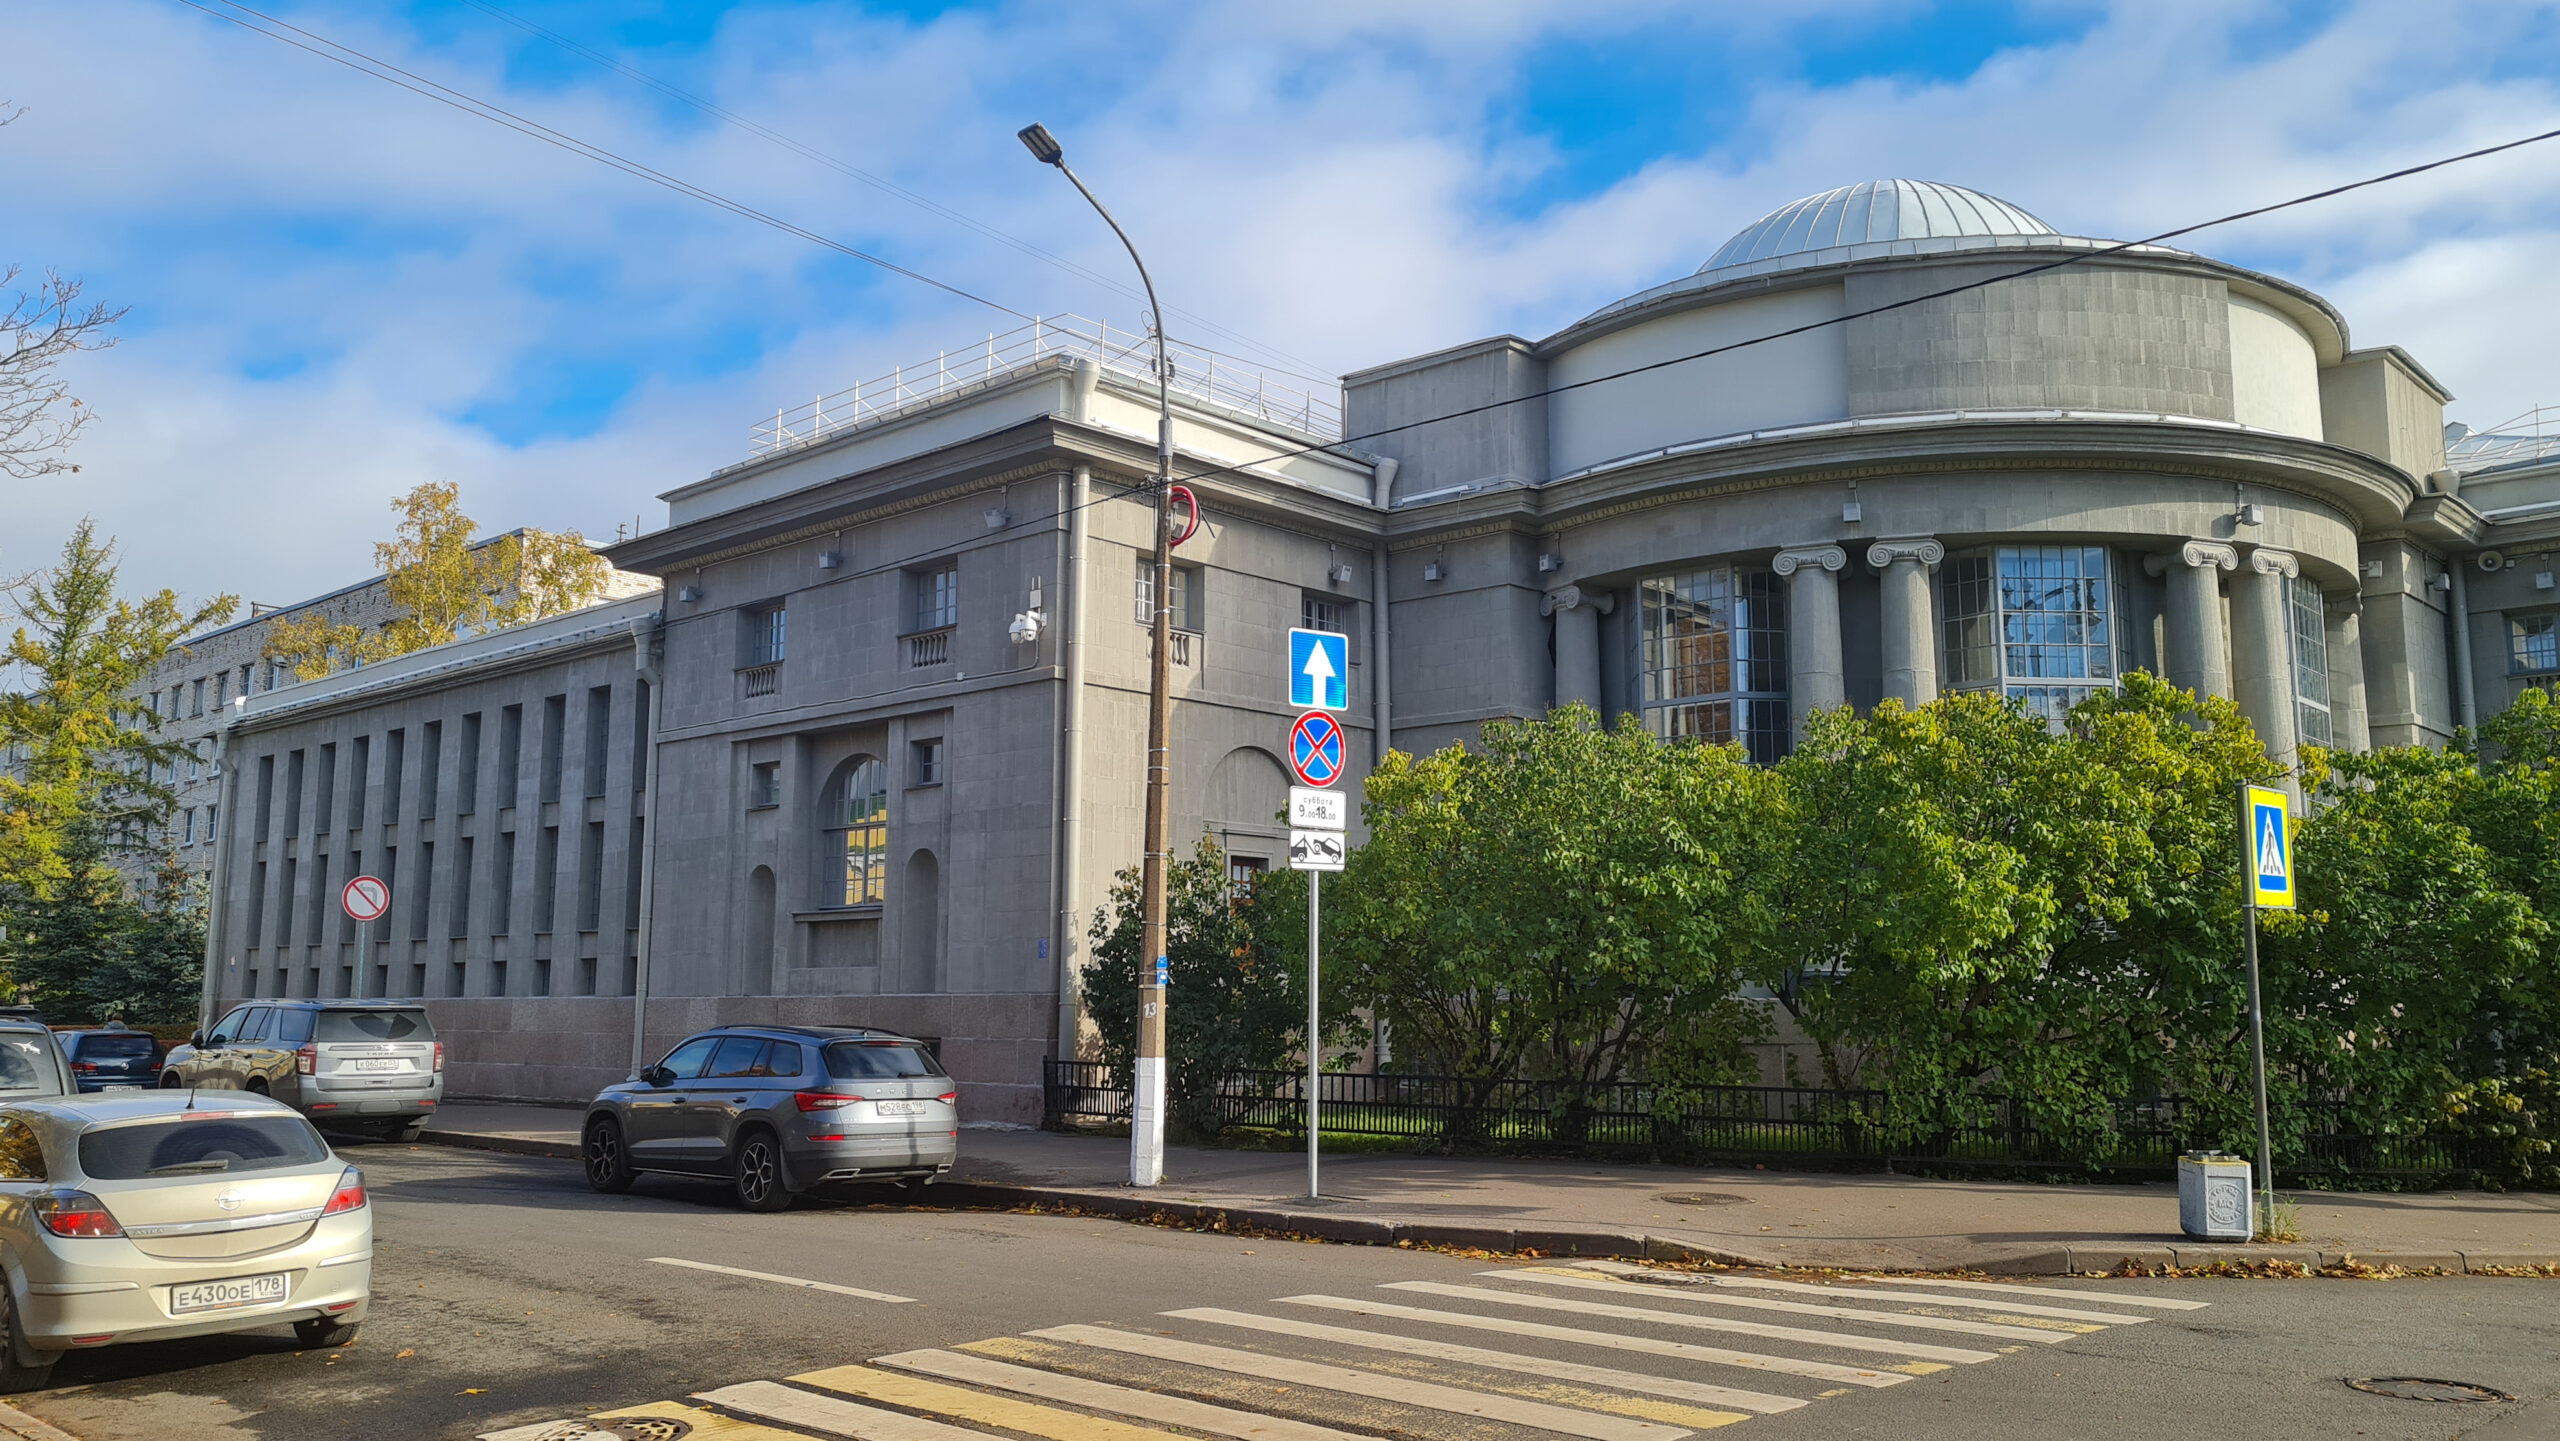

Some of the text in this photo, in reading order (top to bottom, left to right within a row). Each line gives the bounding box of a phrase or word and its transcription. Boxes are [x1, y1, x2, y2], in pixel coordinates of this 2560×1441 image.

[1303, 796, 1333, 806] суббота
[1144, 1001, 1157, 1017] 13
[178, 1277, 280, 1306] Е430ОЕ 178
